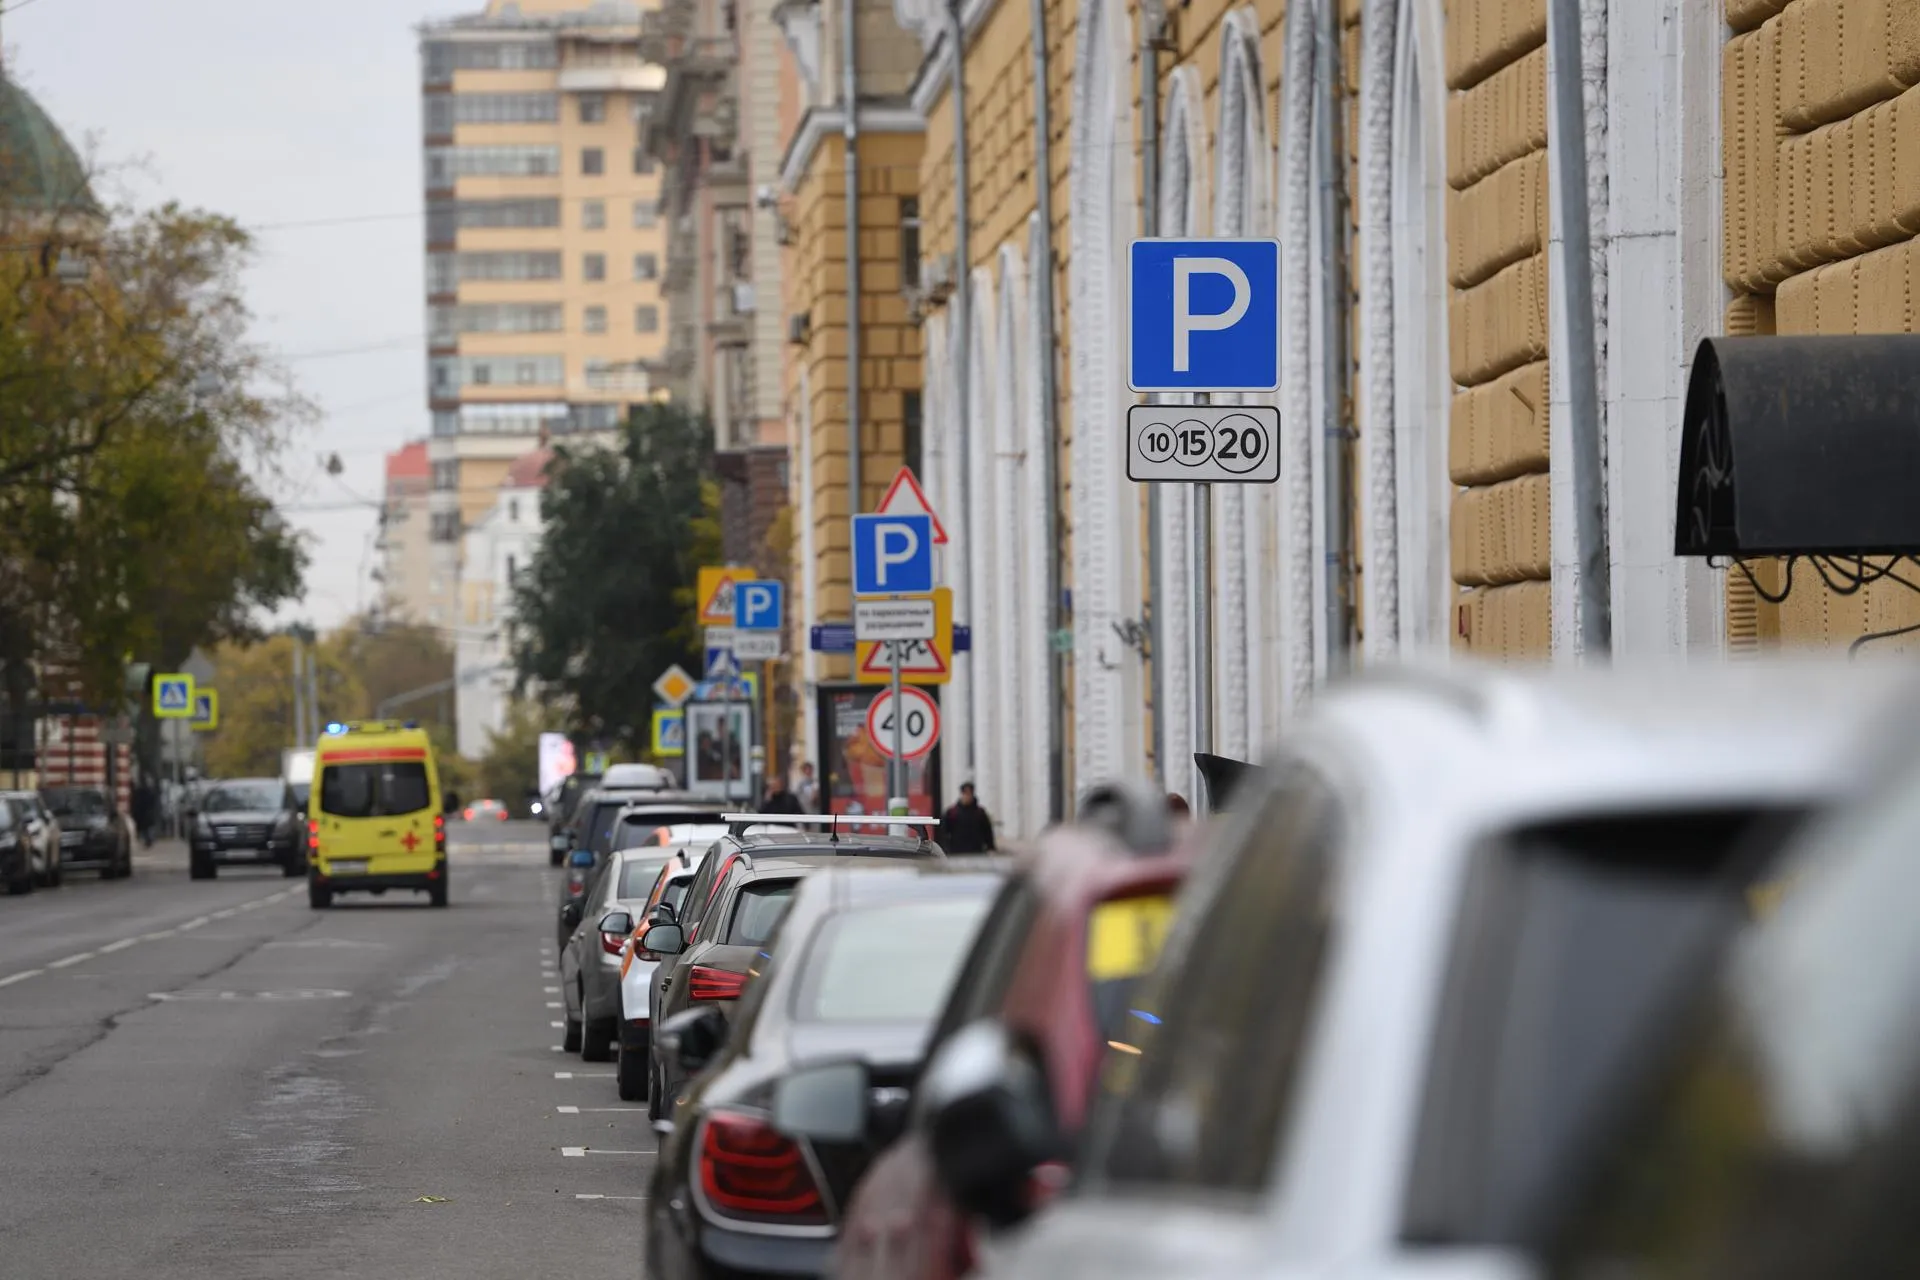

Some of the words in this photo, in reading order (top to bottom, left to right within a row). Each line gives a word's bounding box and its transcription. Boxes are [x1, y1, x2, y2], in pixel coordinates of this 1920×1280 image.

[1173, 257, 1251, 371] P
[1147, 432, 1170, 453] 10
[1178, 430, 1207, 456] 15
[1217, 427, 1261, 459] 20
[875, 523, 918, 585] P
[745, 587, 772, 625] P
